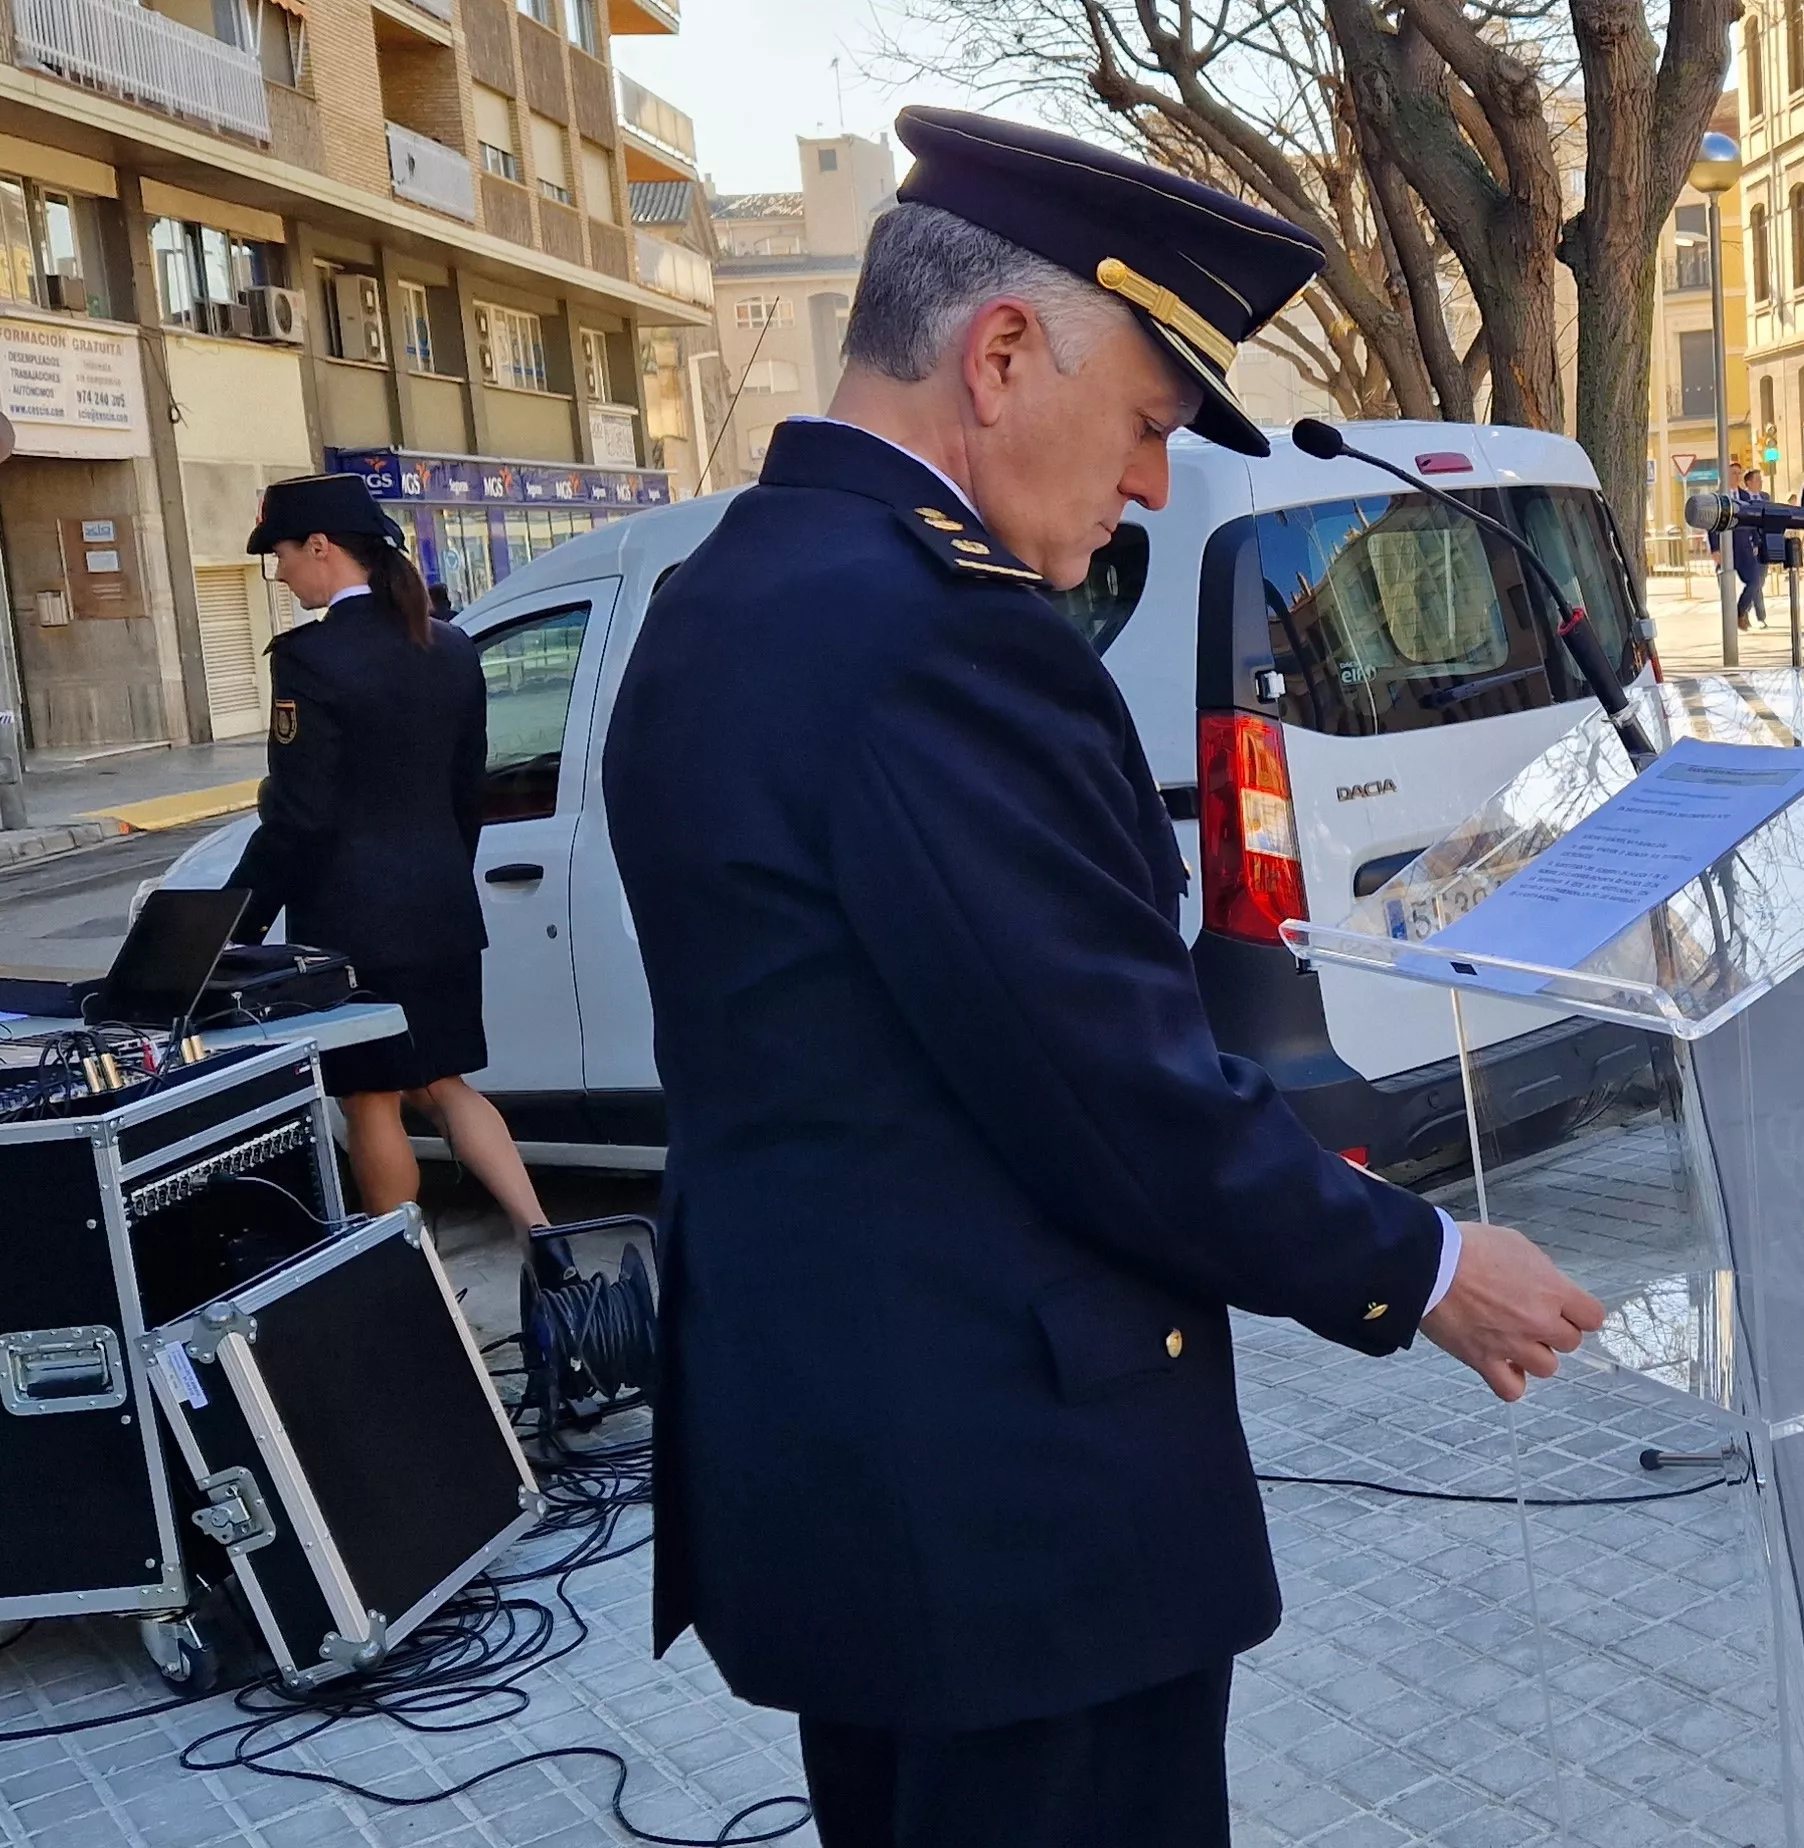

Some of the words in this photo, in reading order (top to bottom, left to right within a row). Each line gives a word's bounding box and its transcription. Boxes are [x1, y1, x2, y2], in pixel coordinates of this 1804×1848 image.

[72, 338, 122, 356] GRATUITA
[363, 473, 393, 488] GS
[483, 477, 504, 498] MGS
[555, 481, 573, 500] MGS
[1336, 779, 1397, 802] DACIA
